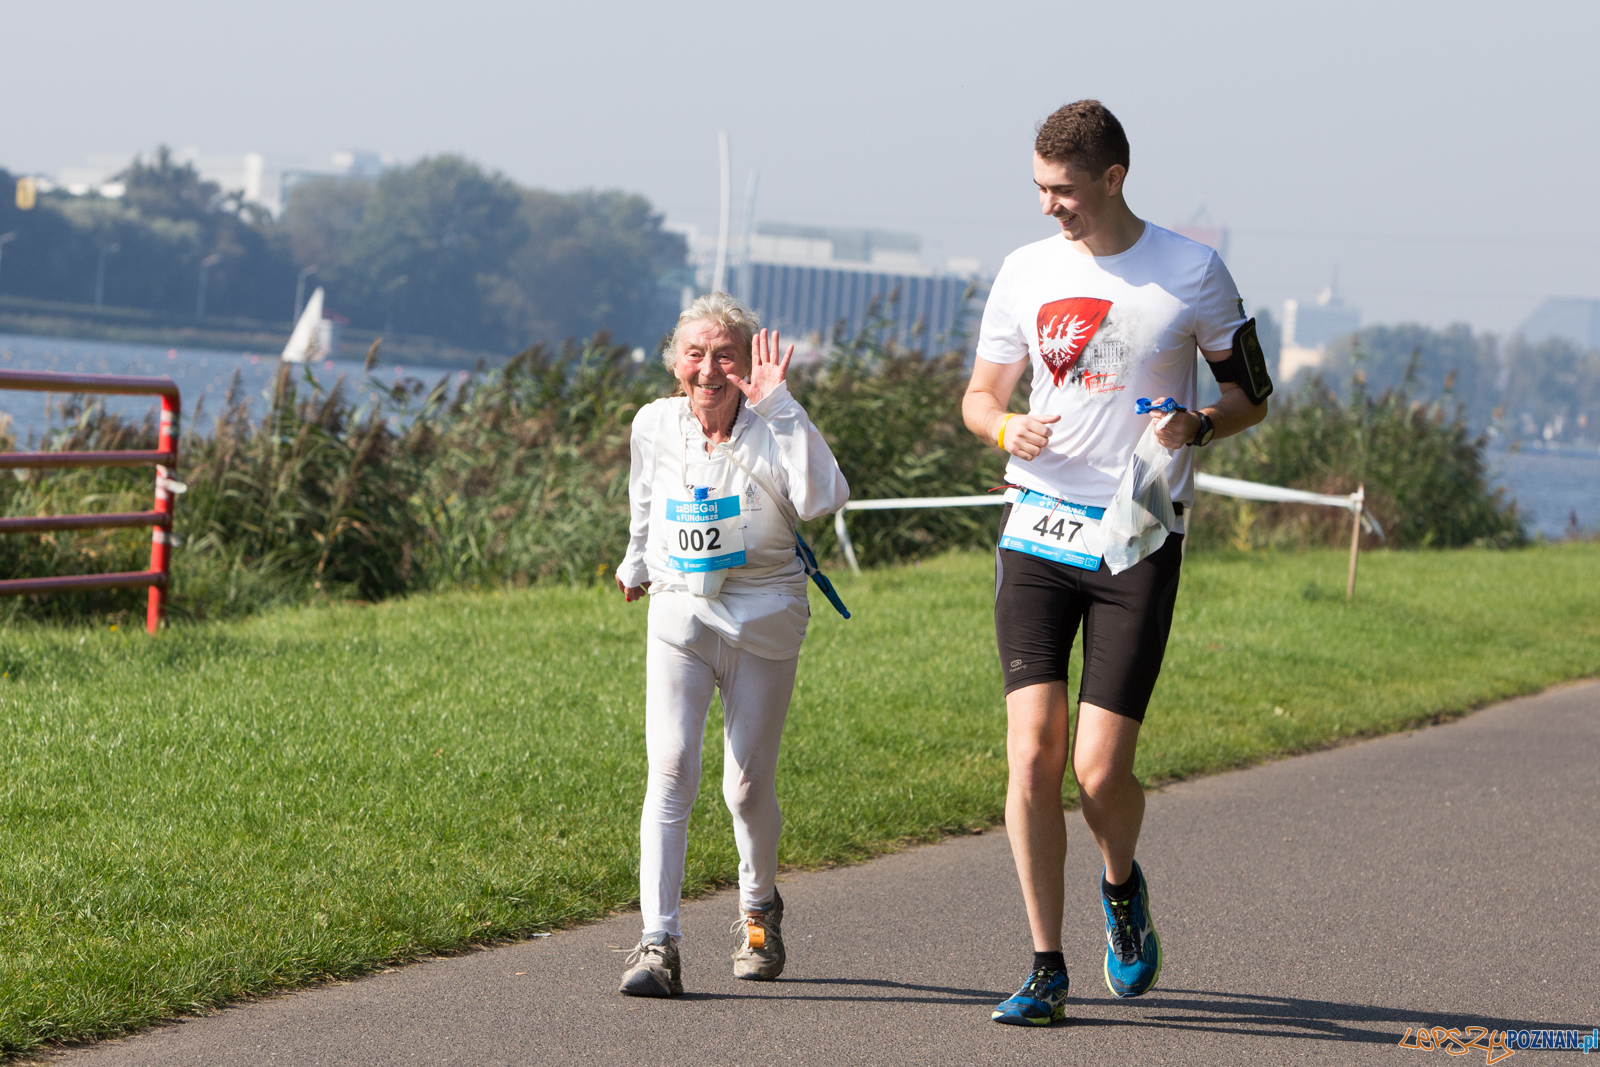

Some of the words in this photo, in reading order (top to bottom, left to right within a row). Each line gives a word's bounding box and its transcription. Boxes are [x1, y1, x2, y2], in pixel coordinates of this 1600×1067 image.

[675, 502, 718, 514] zaBIEGaj
[1046, 501, 1087, 516] FUNdusze
[681, 513, 718, 522] FUNdusze
[1032, 515, 1084, 543] 447
[678, 527, 721, 551] 002
